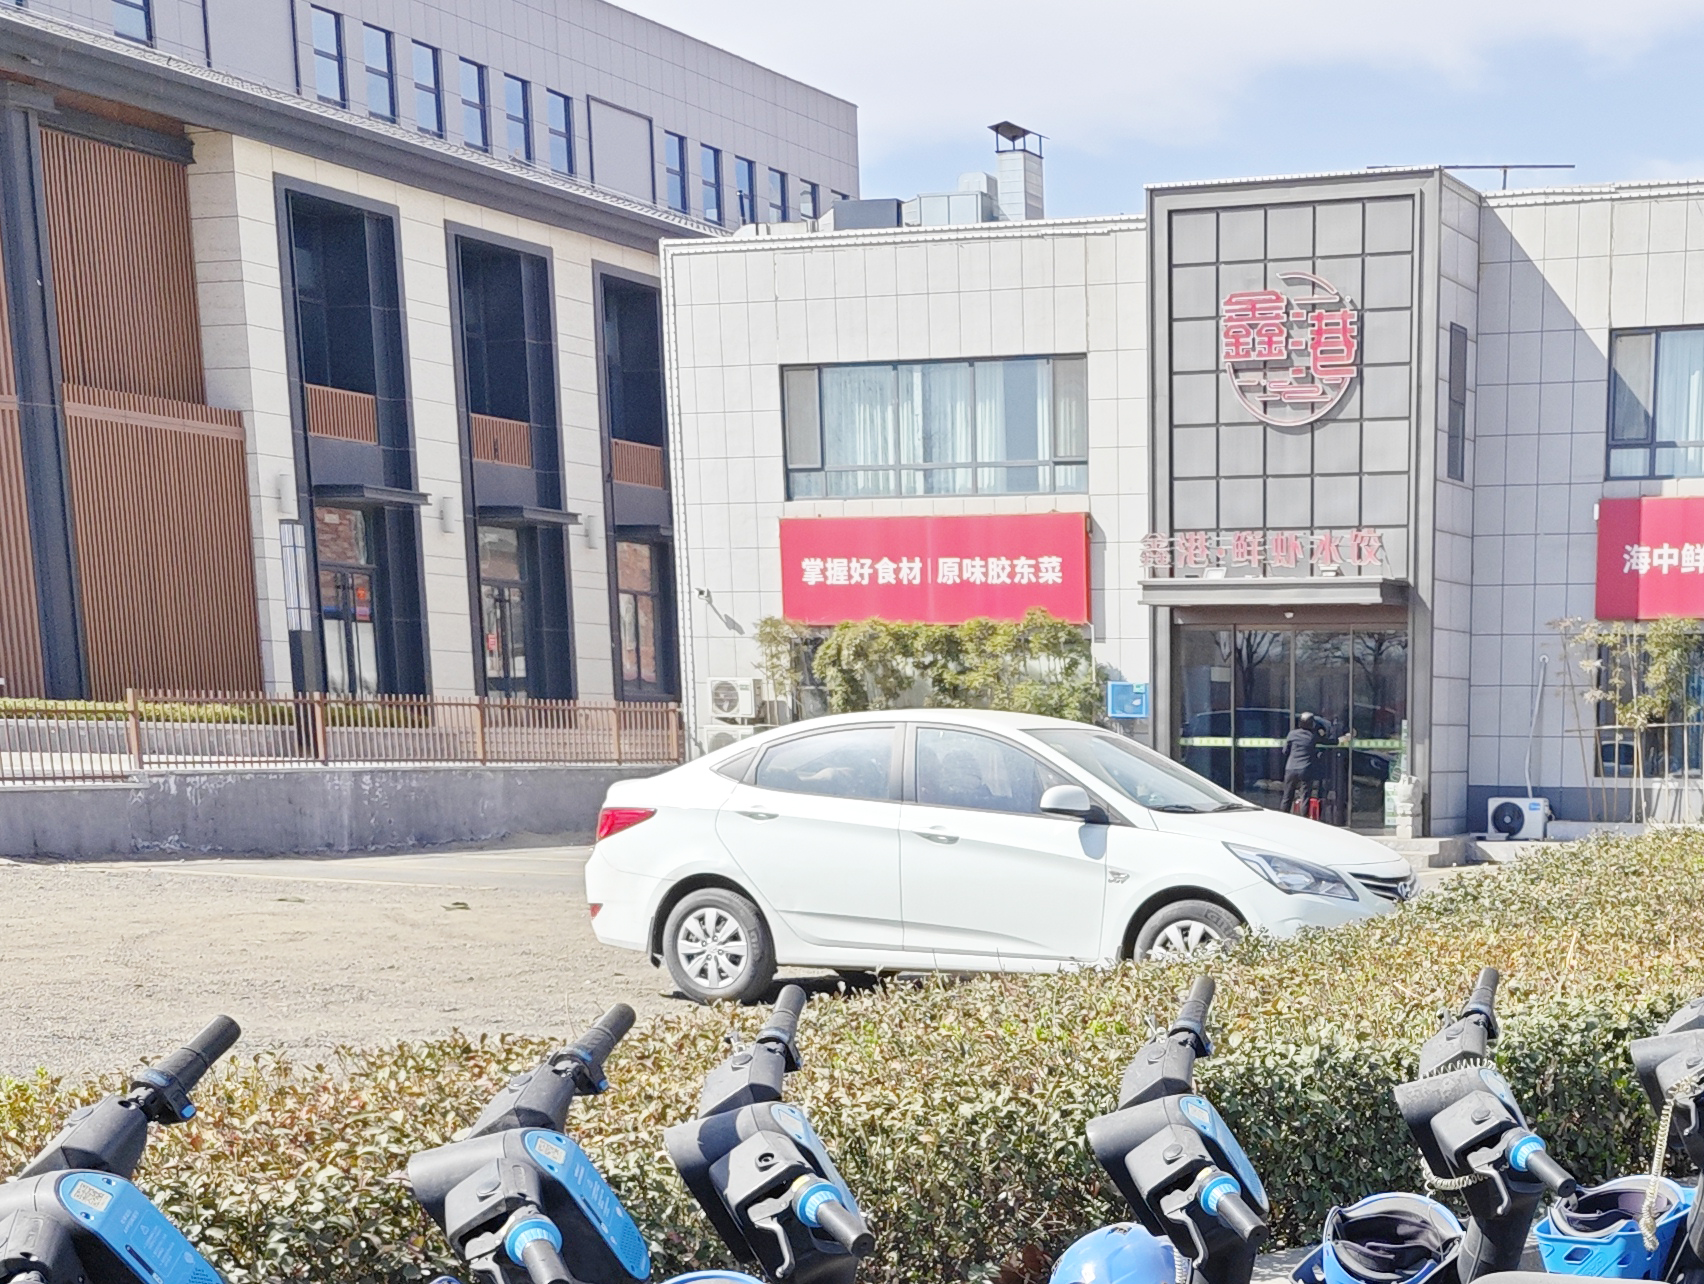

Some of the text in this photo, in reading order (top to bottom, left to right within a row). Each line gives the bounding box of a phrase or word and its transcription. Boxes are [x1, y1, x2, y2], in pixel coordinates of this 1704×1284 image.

[1222, 289, 1358, 379] 鑫港
[801, 556, 1064, 586] 掌握好食材 原味胶东菜
